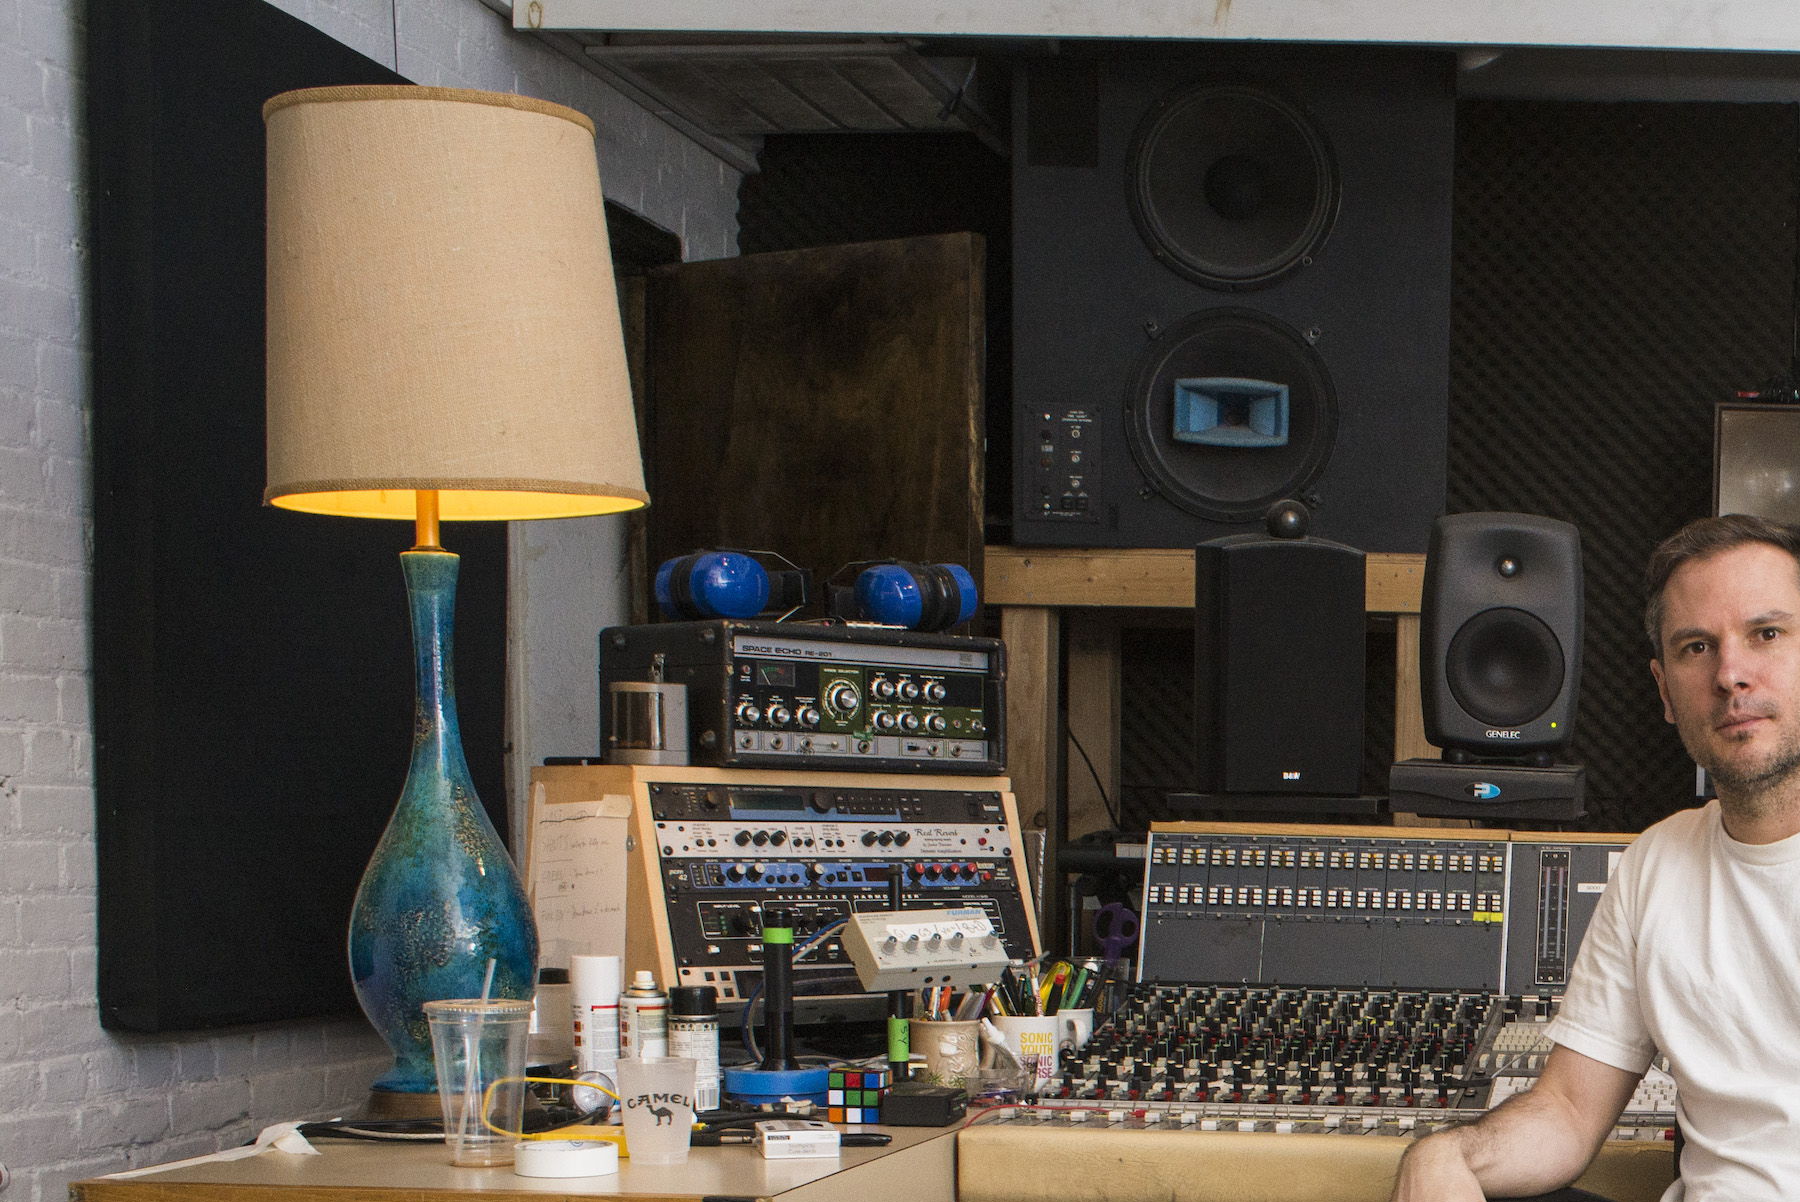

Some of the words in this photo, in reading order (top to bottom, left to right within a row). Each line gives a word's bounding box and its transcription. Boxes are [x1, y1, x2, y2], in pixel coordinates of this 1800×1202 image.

[741, 644, 773, 654] SPACE
[774, 647, 802, 656] ECHO
[804, 650, 833, 658] RE-201
[1485, 729, 1522, 740] GENELEC
[1282, 771, 1301, 781] B&W
[914, 828, 934, 837] Real
[946, 909, 982, 917] FURMAN
[1020, 1032, 1054, 1044] SONIC
[1020, 1043, 1054, 1056] YOUTH
[626, 1093, 691, 1109] CAMEL
